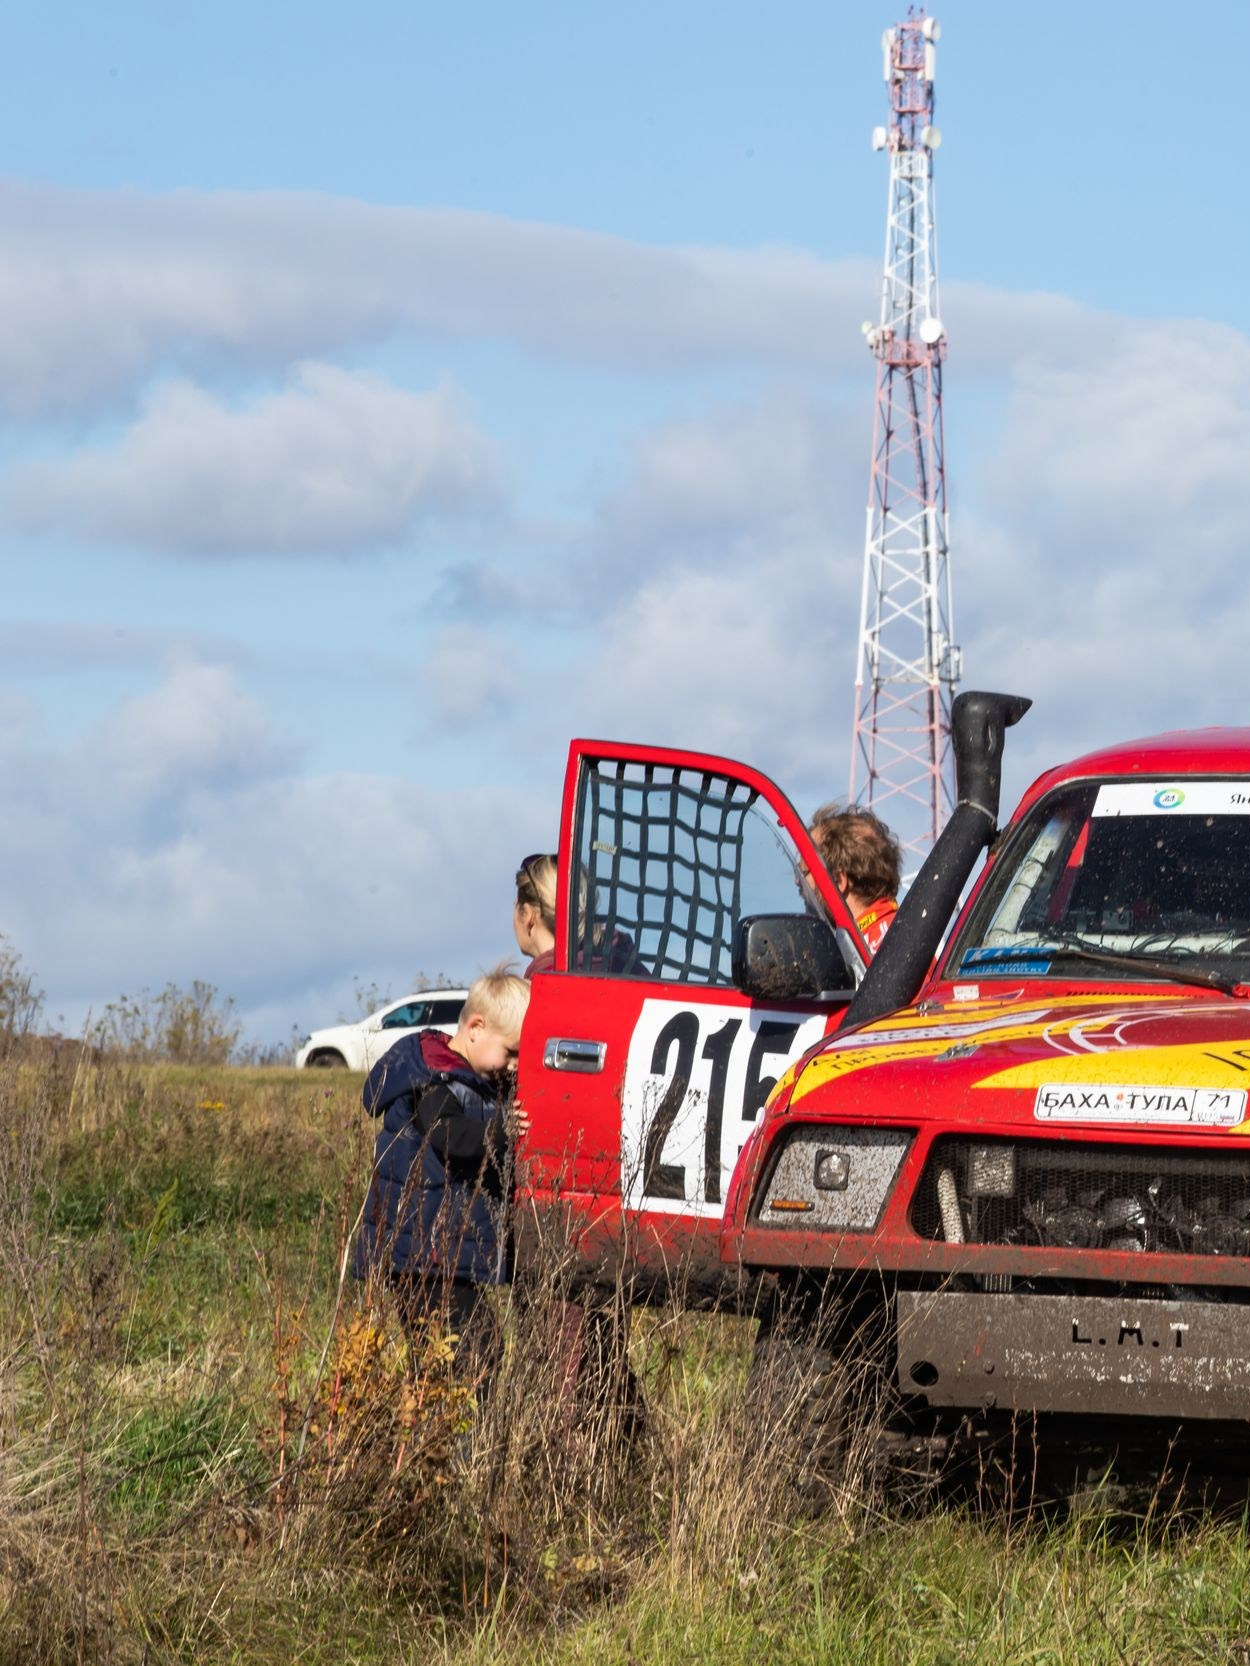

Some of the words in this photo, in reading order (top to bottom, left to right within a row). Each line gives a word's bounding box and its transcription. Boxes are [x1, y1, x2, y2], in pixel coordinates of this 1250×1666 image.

[1044, 1092, 1110, 1109] БАХА
[1128, 1092, 1188, 1111] ТУЛА
[1208, 1093, 1231, 1108] 71
[1072, 1317, 1189, 1348] L.M.T
